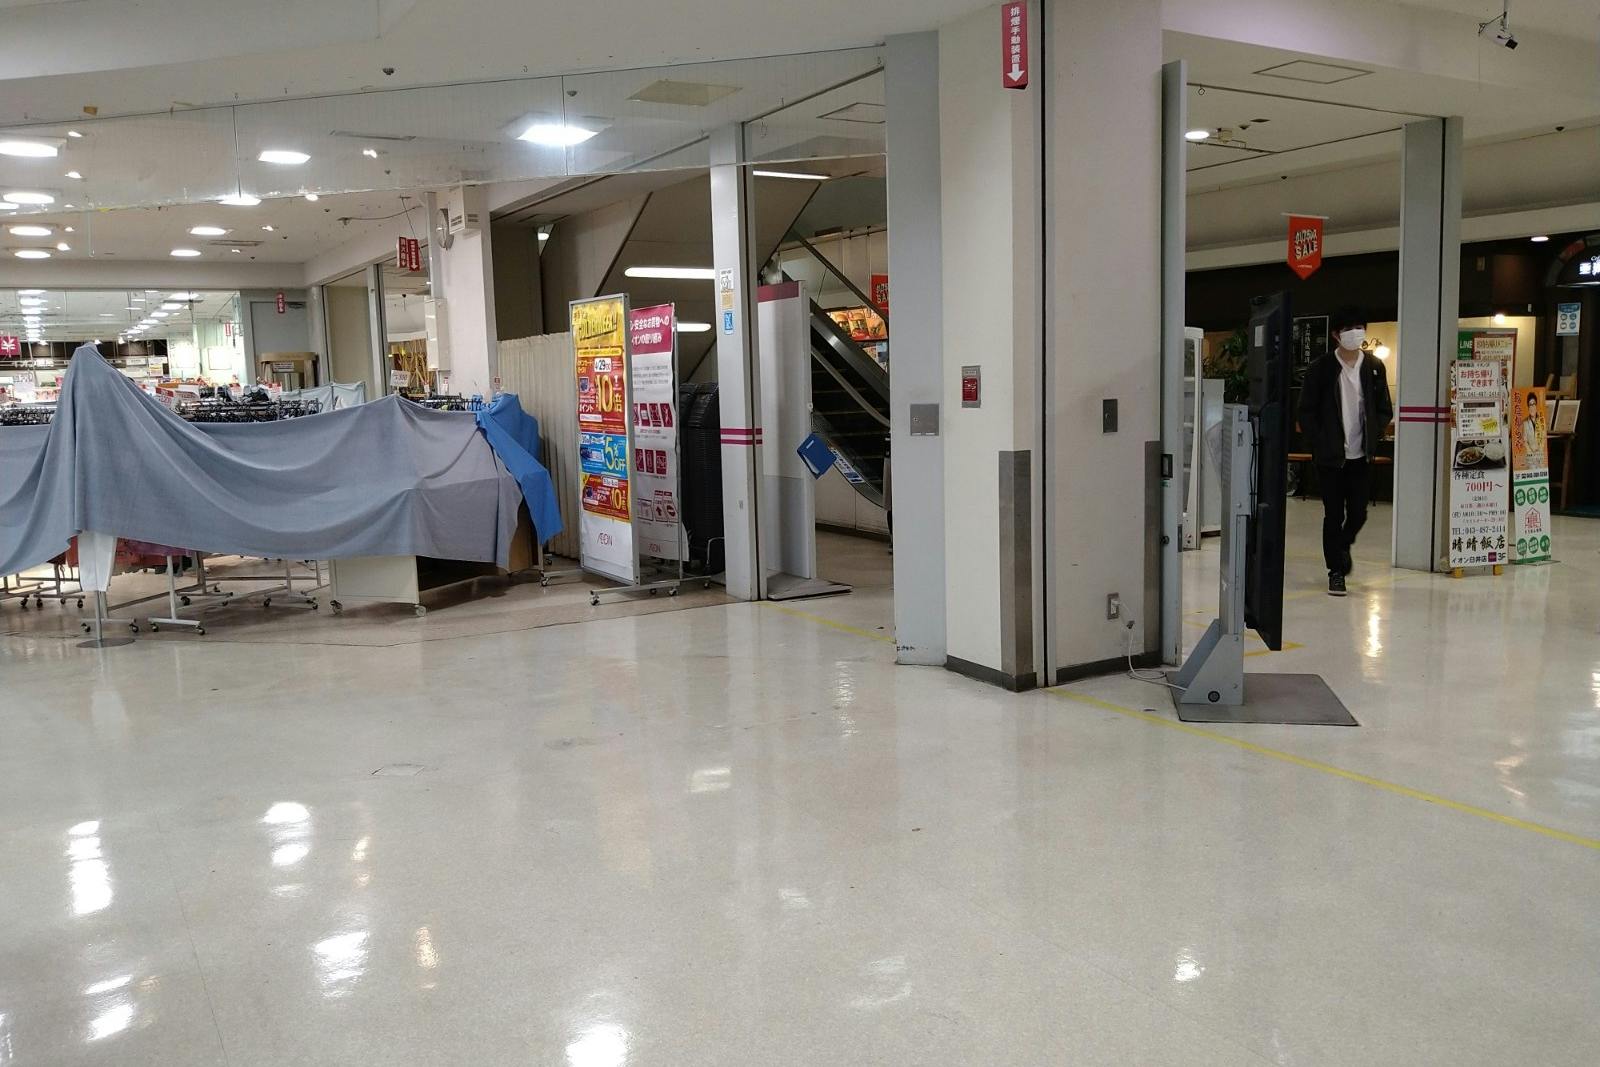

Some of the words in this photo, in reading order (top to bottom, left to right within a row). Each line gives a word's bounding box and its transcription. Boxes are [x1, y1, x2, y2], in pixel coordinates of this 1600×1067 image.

[1295, 240, 1318, 261] SALE
[1460, 340, 1472, 349] LINE
[1460, 370, 1493, 379] お持ち帰り
[614, 459, 626, 472] OFF
[1454, 470, 1486, 480] 各種定食
[1498, 552, 1506, 560] 3F
